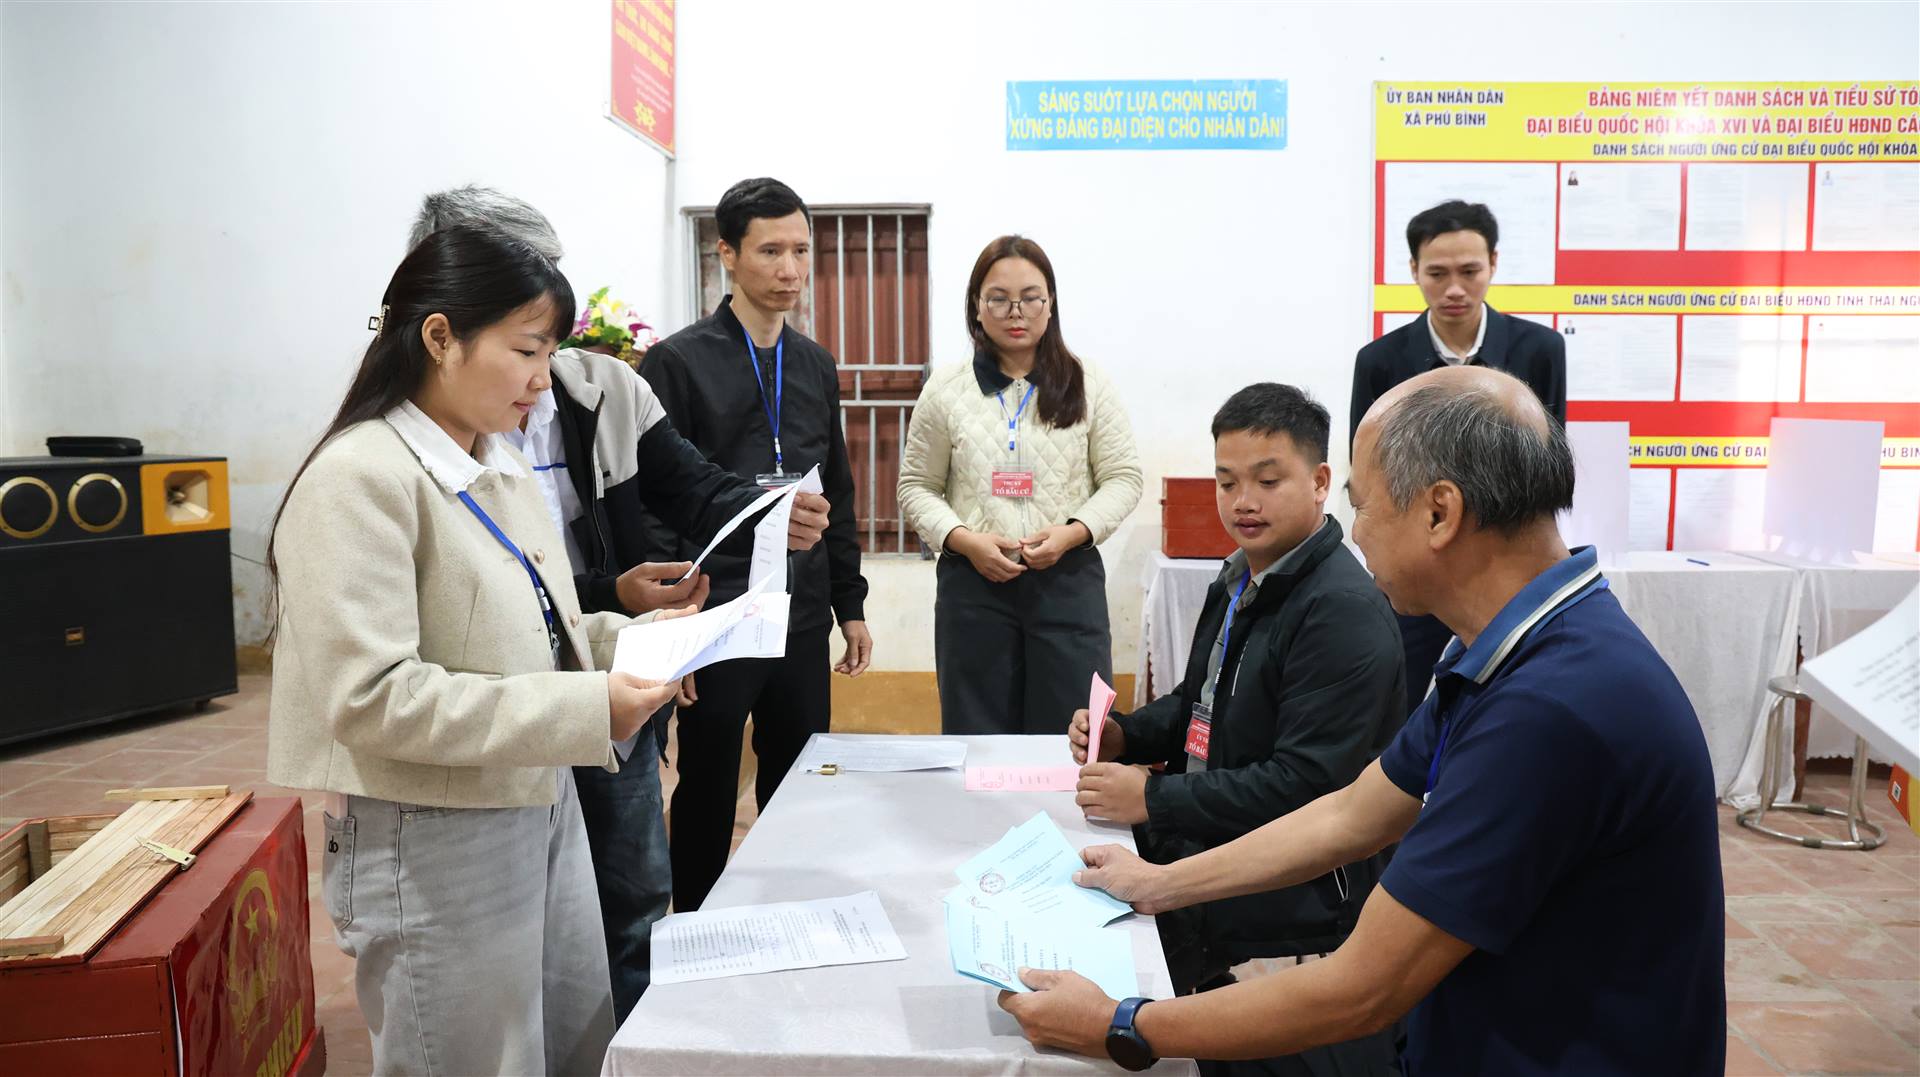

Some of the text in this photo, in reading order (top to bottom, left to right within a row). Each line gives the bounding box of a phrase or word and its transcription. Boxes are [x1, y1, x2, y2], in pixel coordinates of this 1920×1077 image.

[1039, 85, 1257, 117] SÁNG SUỐT LỰA CHỌN NGƯỜI
[1387, 87, 1504, 104] ỦY BAN NHÂN DÂN
[1589, 86, 1631, 106] BẢNG
[1714, 91, 1757, 107] DANH
[1762, 88, 1804, 106] SÁCH
[1810, 88, 1829, 106] VÀ
[1834, 84, 1868, 106] TIỂU
[1873, 85, 1896, 106] SỬ
[1900, 87, 1920, 106] TÓ
[1426, 110, 1451, 125] PHÚ
[1456, 110, 1486, 125] BÌNH
[1527, 118, 1553, 137] ĐẠI
[1558, 111, 1593, 133] BIỂU
[1598, 112, 1639, 135] QUỐC
[1645, 115, 1670, 136] HỘI
[1723, 118, 1746, 133] XVI
[1752, 114, 1771, 133] VÀ
[1777, 118, 1802, 137] ĐẠI
[1808, 111, 1844, 133] BIỂU
[1849, 118, 1892, 133] HĐND
[1898, 113, 1920, 133] CÁ
[1010, 112, 1053, 139] XỨNG
[1056, 112, 1098, 139] ĐÁNG
[1102, 117, 1127, 144] ĐẠI
[1131, 115, 1165, 143] DIỆN
[1169, 116, 1201, 139] CHO
[1204, 112, 1246, 138] NHÂN
[1593, 144, 1627, 156] DANH
[1631, 142, 1664, 156] SÁCH
[1669, 142, 1707, 156] NGƯỜI
[1763, 144, 1783, 158] ĐẠI
[1788, 139, 1816, 156] BIỂU
[1821, 141, 1854, 156] QUỐC
[1859, 142, 1879, 158] HỘI
[1884, 141, 1917, 156] KHÓA
[1574, 294, 1607, 306] DANH
[1612, 292, 1643, 306] SÁCH
[1649, 292, 1686, 306] NGƯỜI
[1901, 295, 1920, 306] NG
[1647, 443, 1686, 457] NGƯỜI
